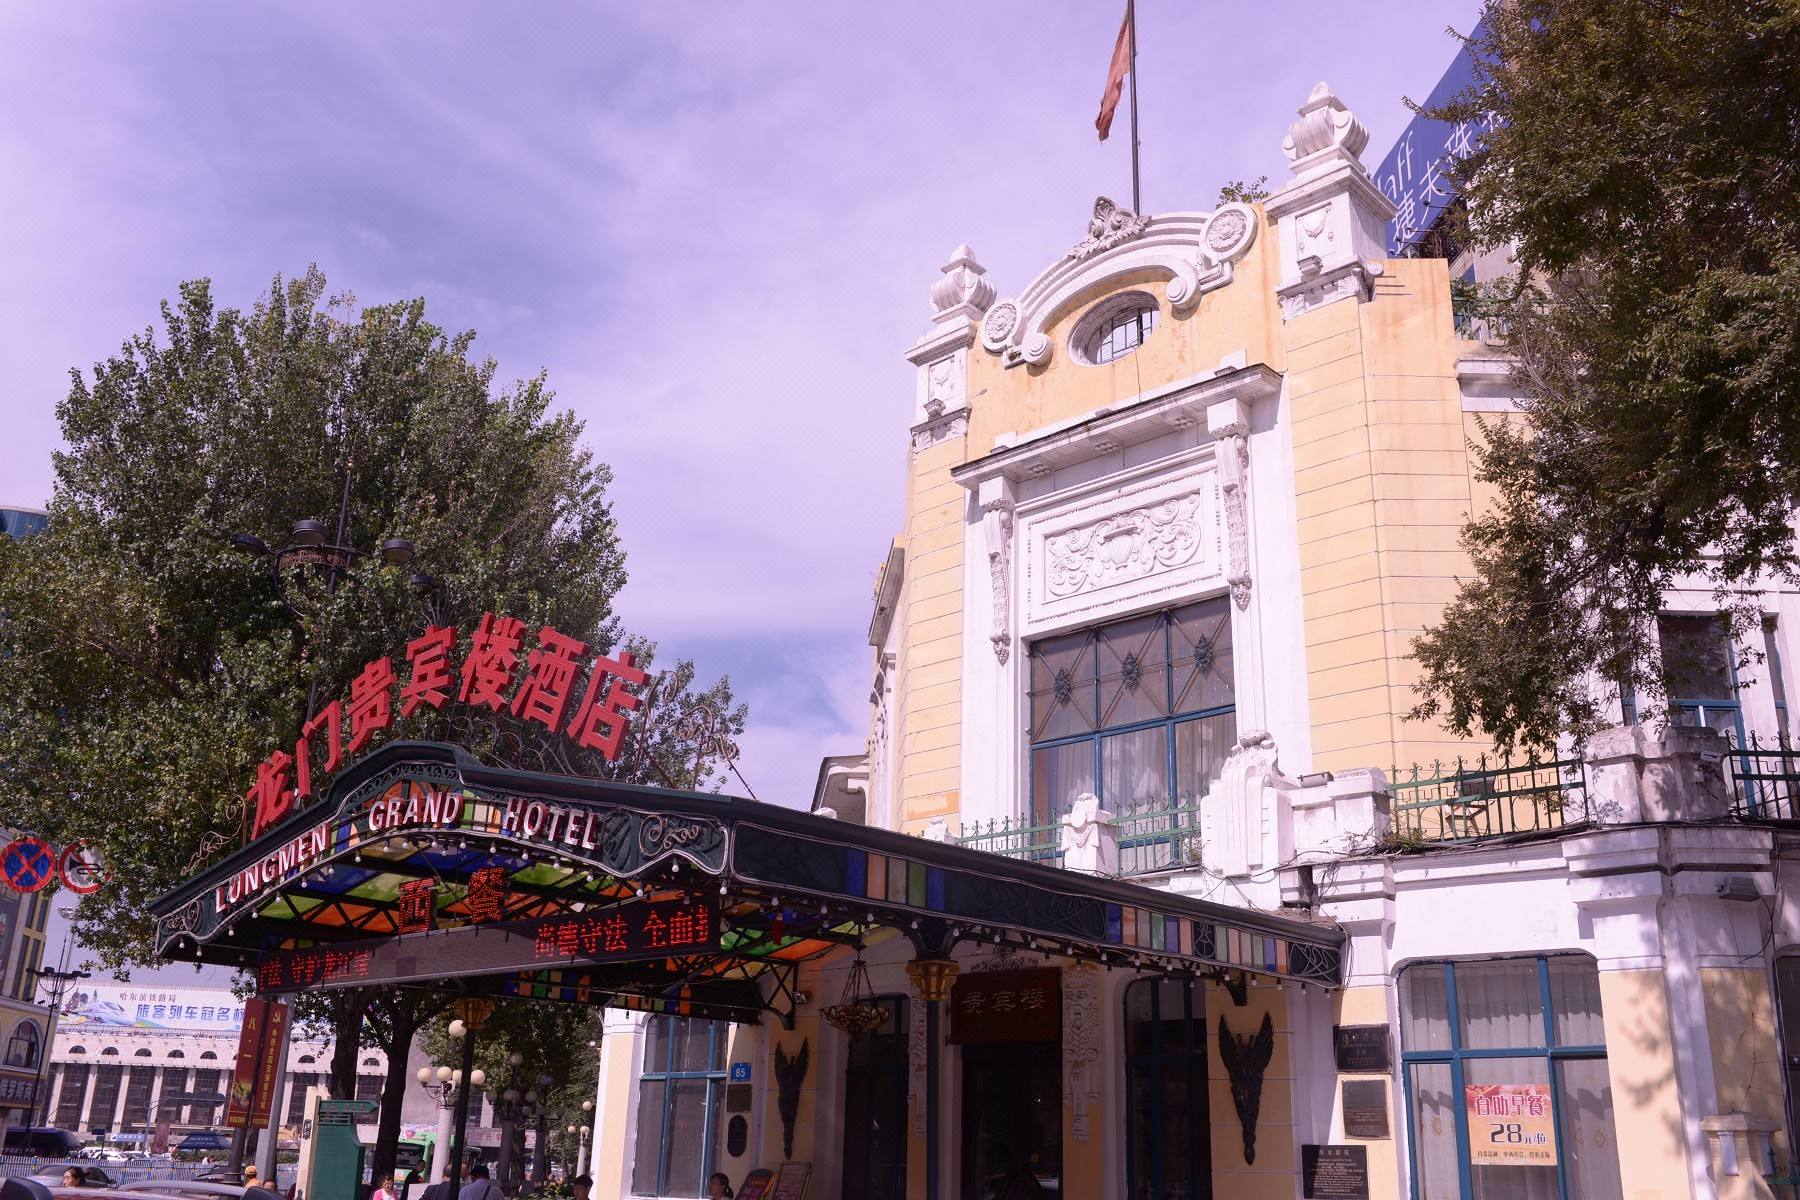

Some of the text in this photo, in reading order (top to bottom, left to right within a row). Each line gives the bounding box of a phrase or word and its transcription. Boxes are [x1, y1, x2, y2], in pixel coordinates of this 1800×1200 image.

[246, 611, 652, 841] 龙门贵宾楼酒店
[215, 792, 601, 914] LONGMEN GRAND HOTEL
[399, 867, 505, 934] 西餐
[119, 992, 177, 1004] 哈尔滨铁路局
[962, 987, 1044, 1016] 贵宾楼
[735, 1067, 746, 1078] 85
[1476, 1094, 1544, 1116] 自助早餐
